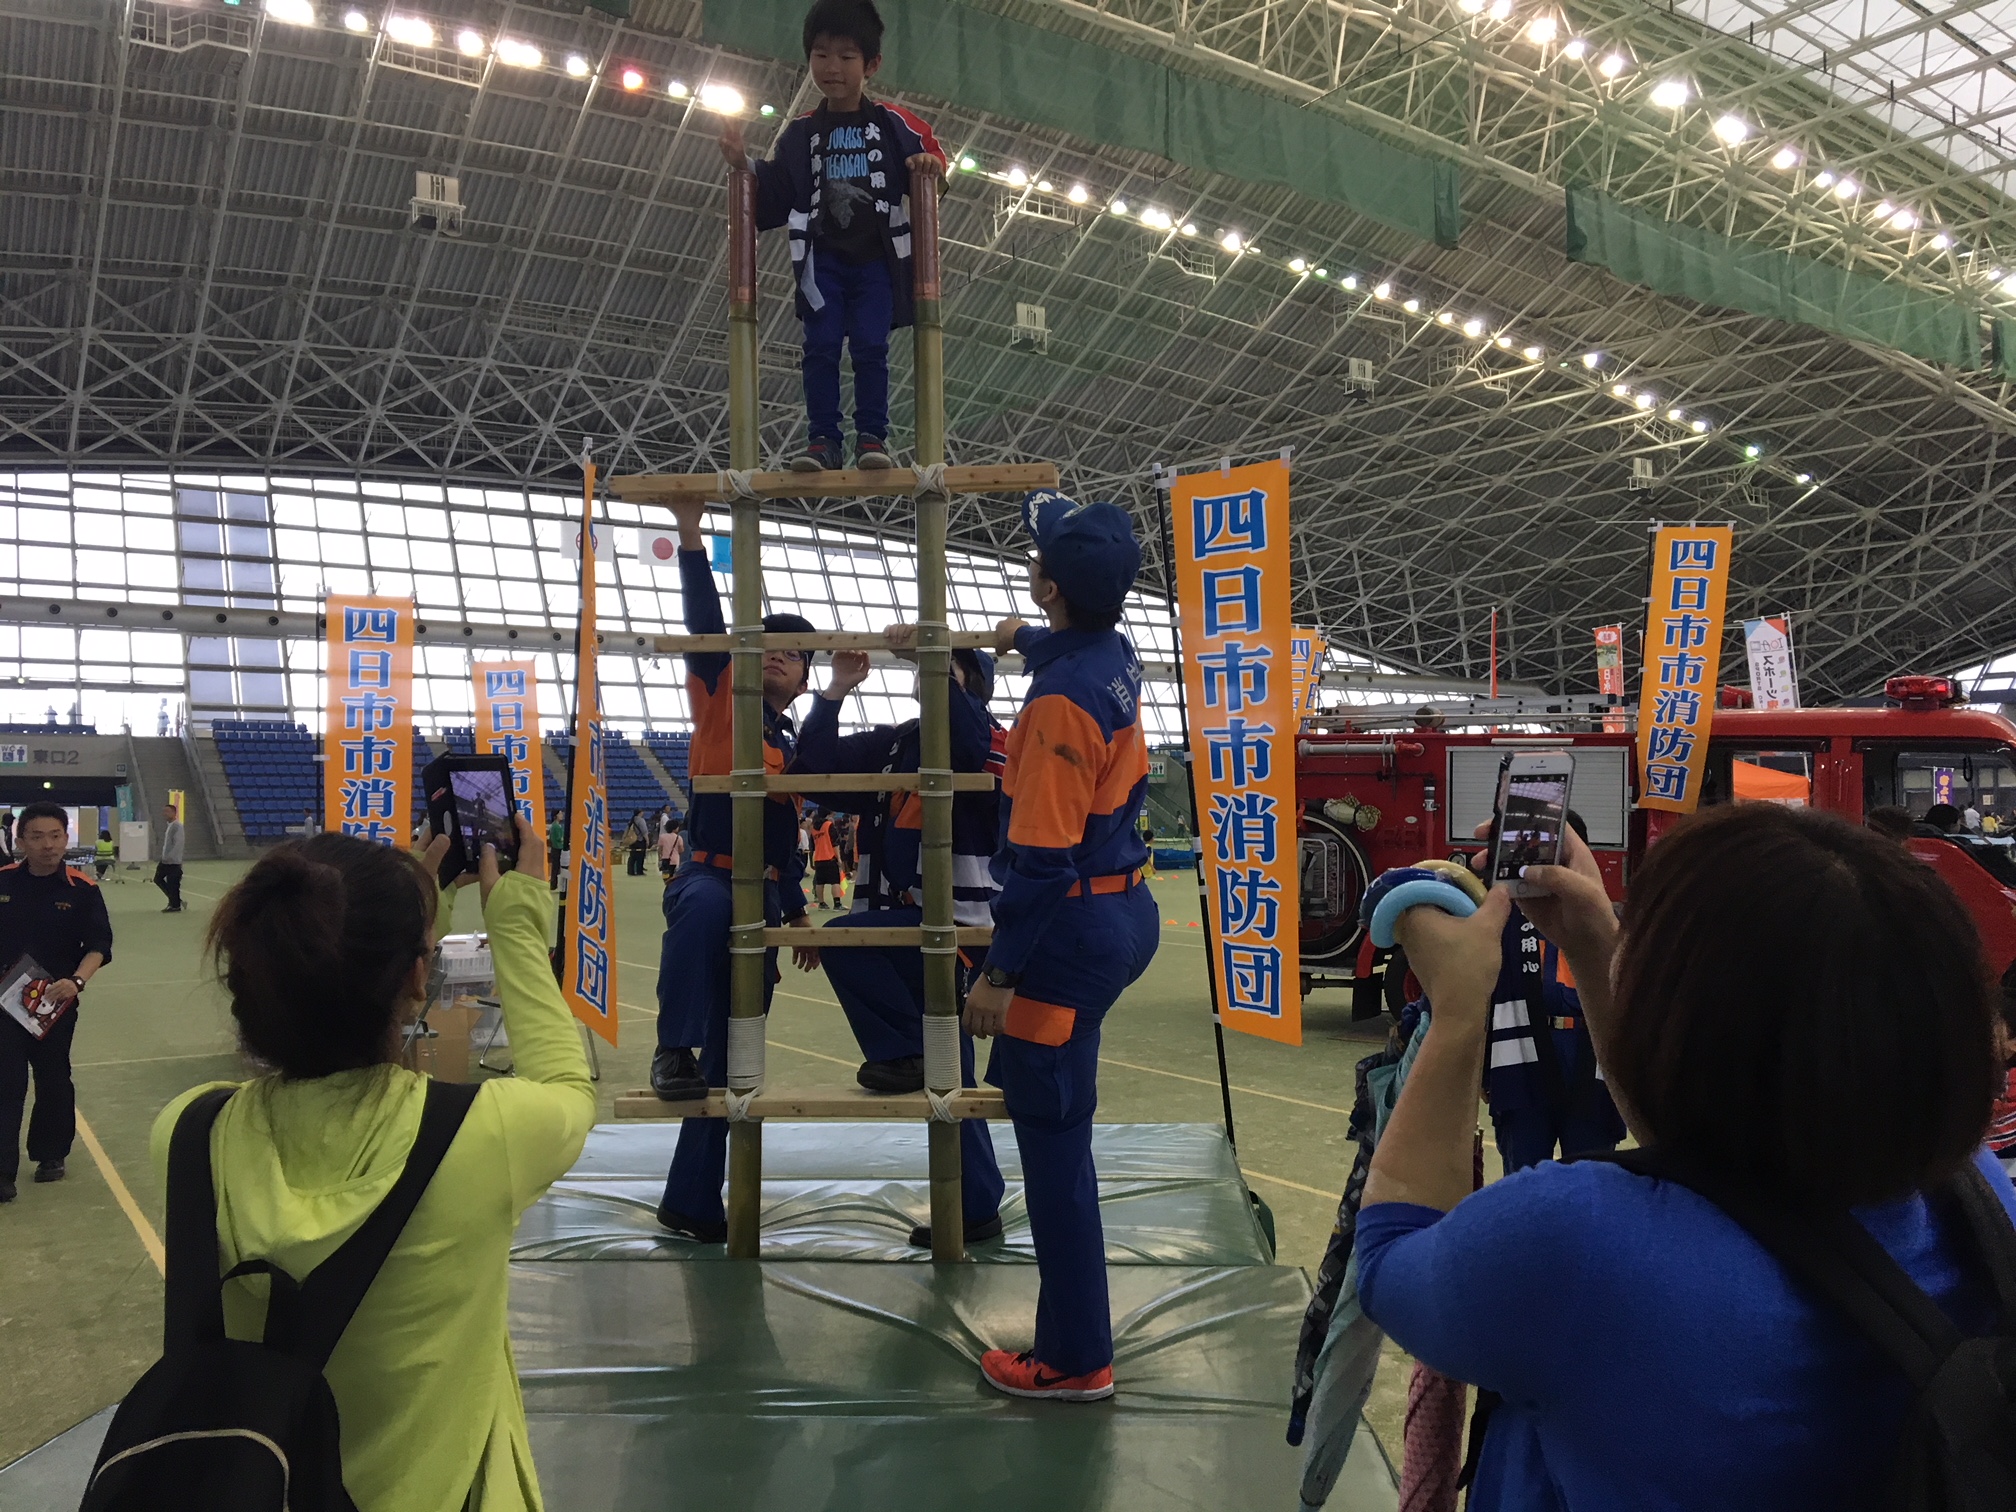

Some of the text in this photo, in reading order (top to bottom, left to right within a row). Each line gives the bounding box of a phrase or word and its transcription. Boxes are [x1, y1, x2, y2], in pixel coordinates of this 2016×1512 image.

[823, 153, 870, 180] TEGOSAU
[864, 121, 890, 214] 火の用心
[1644, 538, 1718, 802] 四日市市消防団
[33, 749, 80, 766] 東口2
[1191, 487, 1283, 1019] 四日市市消防団
[1521, 915, 1540, 973] の用心
